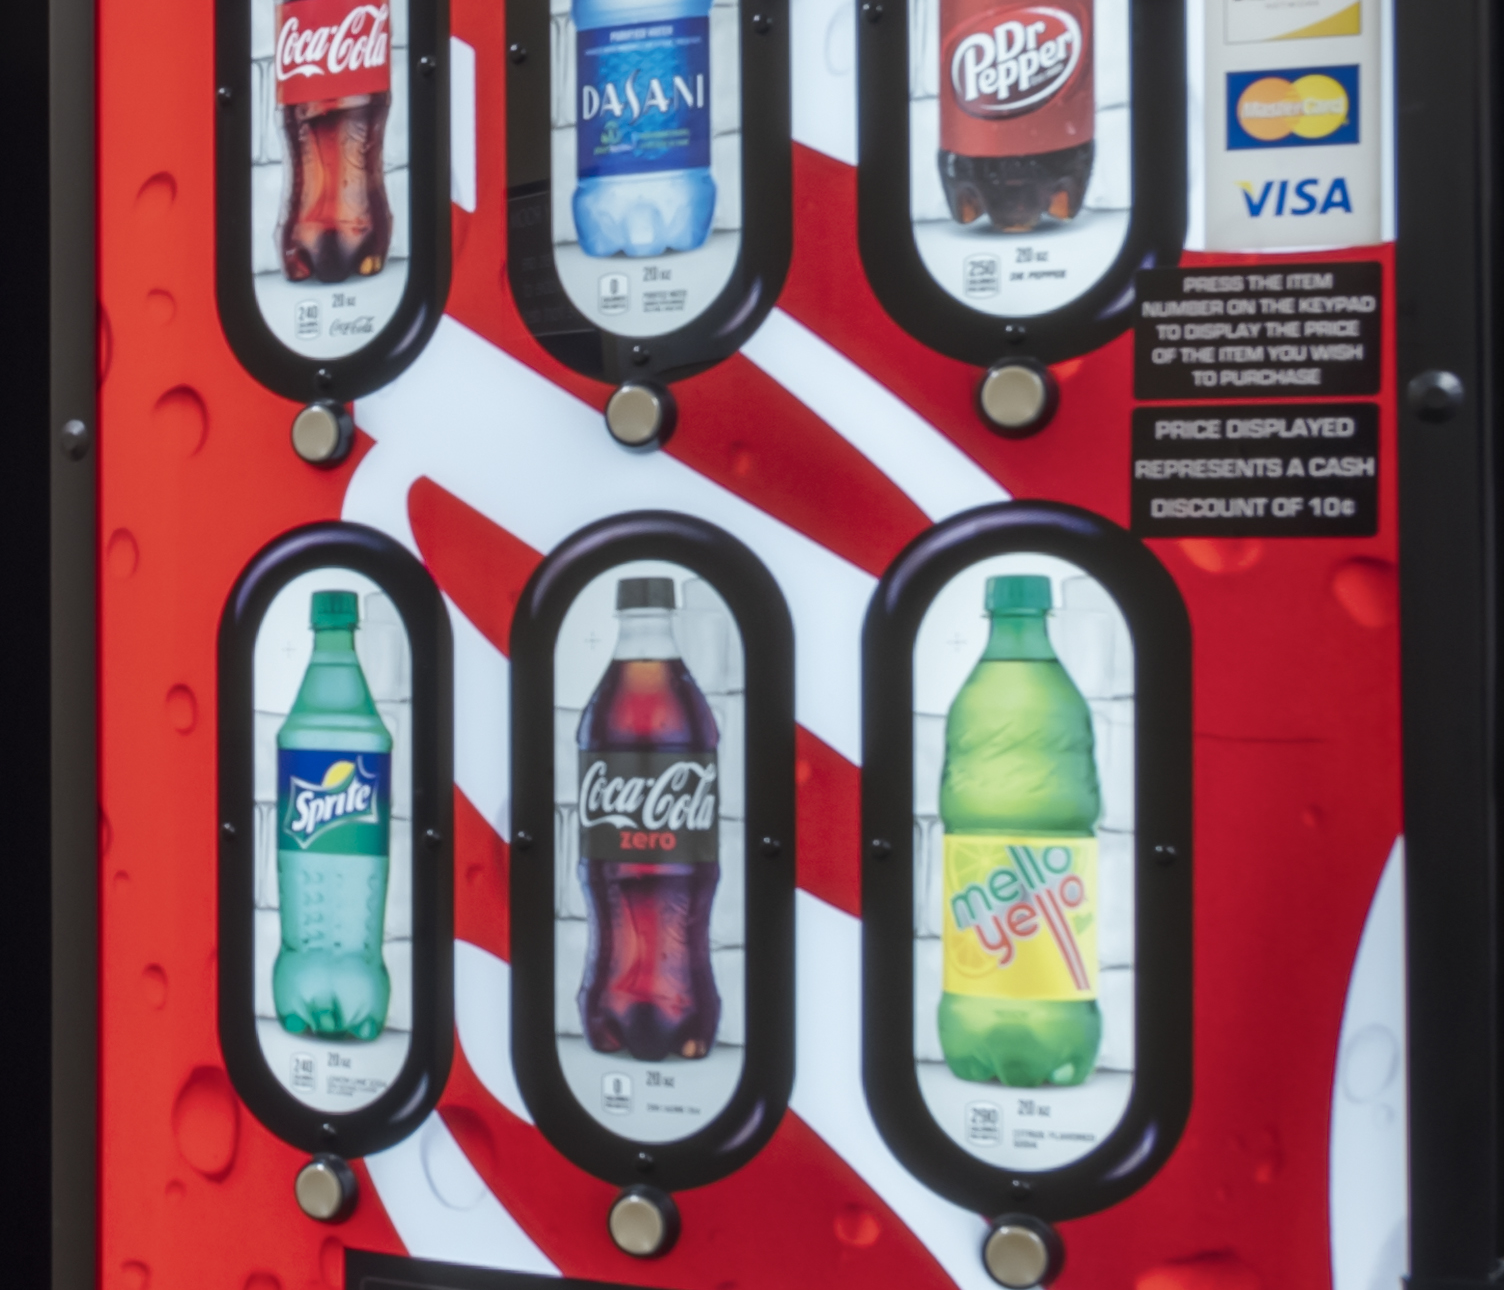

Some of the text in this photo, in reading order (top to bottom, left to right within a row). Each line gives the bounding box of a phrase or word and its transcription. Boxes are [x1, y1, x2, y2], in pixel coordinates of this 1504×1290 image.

[275, 4, 389, 82] Coca-Cola
[996, 21, 1046, 60] Dr
[961, 27, 1073, 104] Pepper
[582, 69, 704, 127] DASANI
[1235, 177, 1353, 218] VISA
[1182, 272, 1334, 293] PRESS THE ITEM
[1141, 295, 1376, 318] NUMBER ON THE KEYPAD
[1155, 319, 1361, 341] TO DISPLAY THE PRICE
[1151, 343, 1365, 364] OF THE ITEM YOU WISH
[1191, 367, 1322, 387] TO PURCHASE
[1155, 417, 1355, 440] PRICE DISPLAYED
[1134, 456, 1375, 479] REPRESENTS A CASH
[1150, 496, 1356, 518] DISCOUNT OF 10¢
[292, 778, 372, 834] Sprite
[581, 759, 717, 830] Coca-Cola
[619, 827, 677, 852] zero
[951, 843, 1073, 930] mello
[974, 874, 1090, 991] yello
